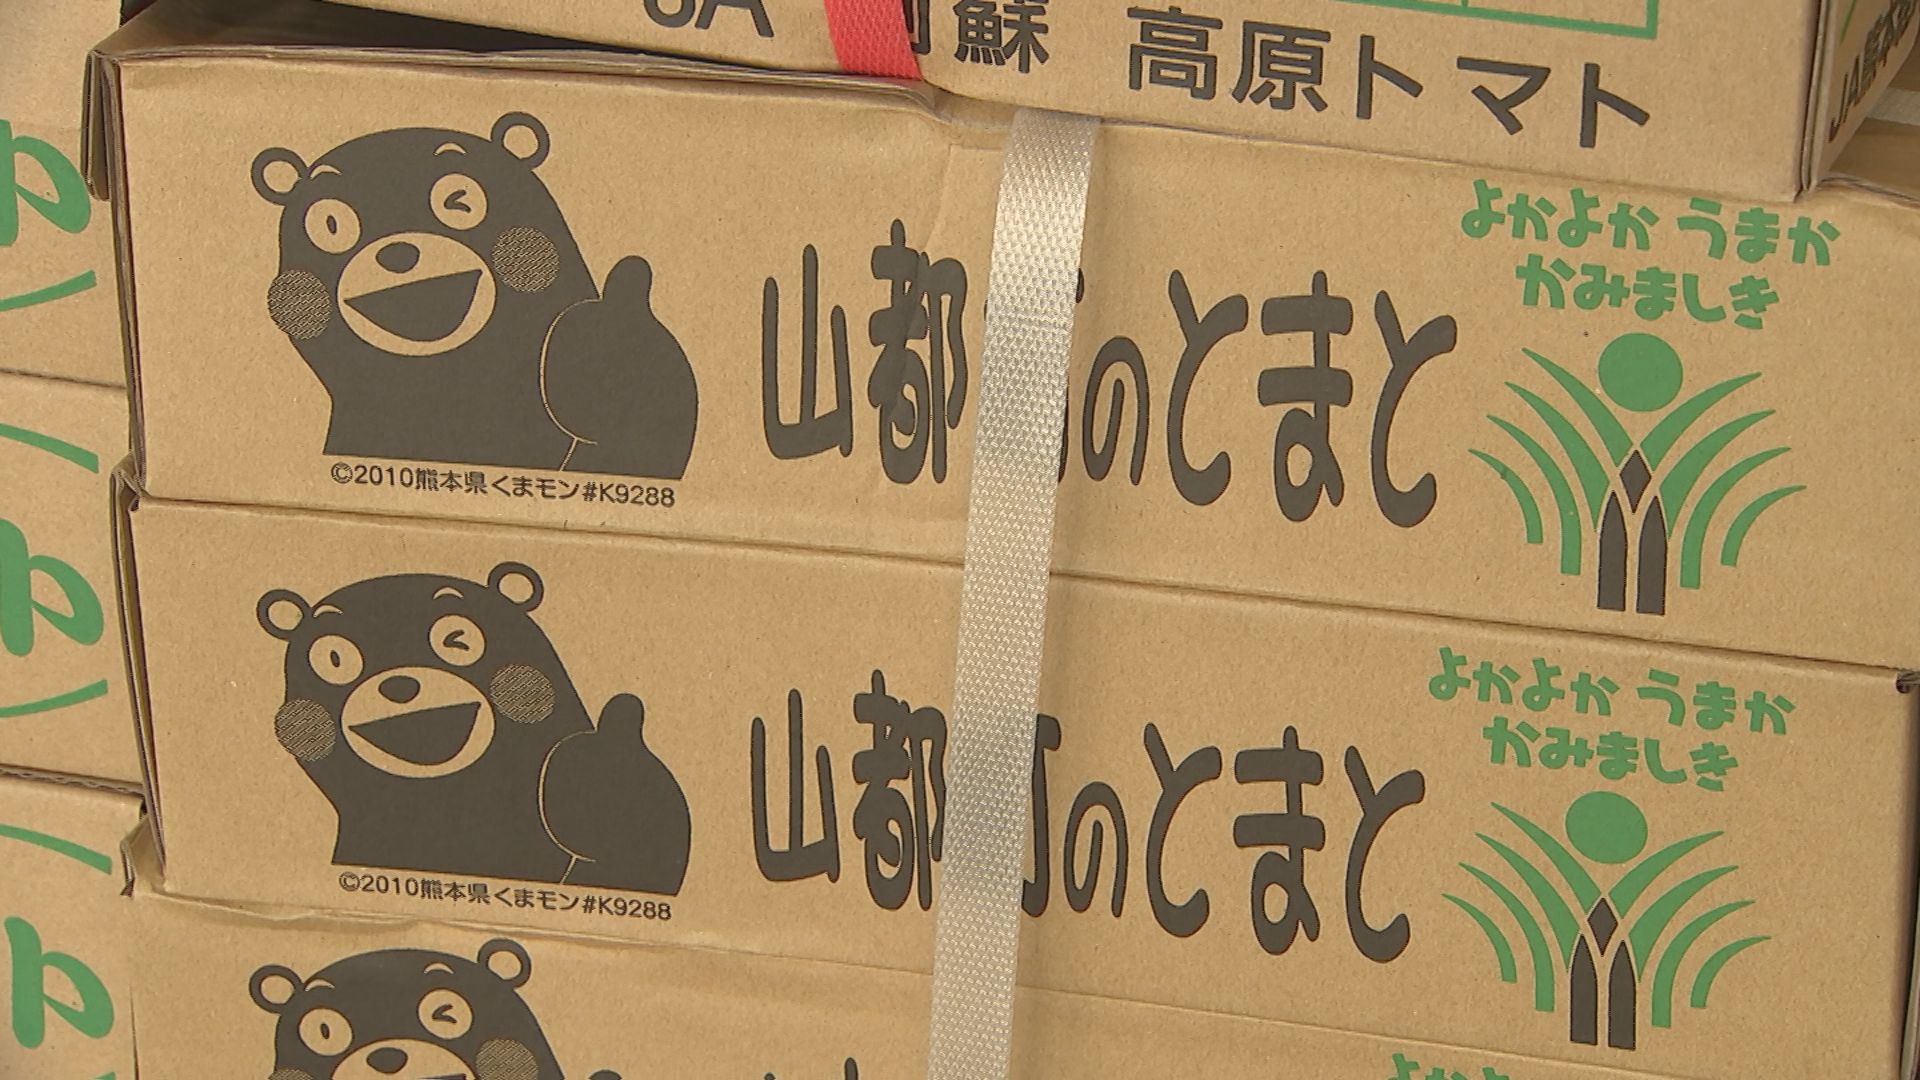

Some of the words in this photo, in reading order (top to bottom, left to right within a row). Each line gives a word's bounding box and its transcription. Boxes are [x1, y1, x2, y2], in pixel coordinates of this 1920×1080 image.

[904, 0, 1050, 74] 蘇
[1126, 5, 1651, 149] 高原トマト
[1460, 178, 1660, 251] よかよか
[1676, 196, 1841, 266] うまか
[1515, 253, 1780, 330] かみましき
[761, 218, 1458, 528] 山都のとまと
[1428, 646, 1621, 717] よかよか
[1636, 667, 1797, 736] うまか
[1482, 716, 1739, 793] かみましき
